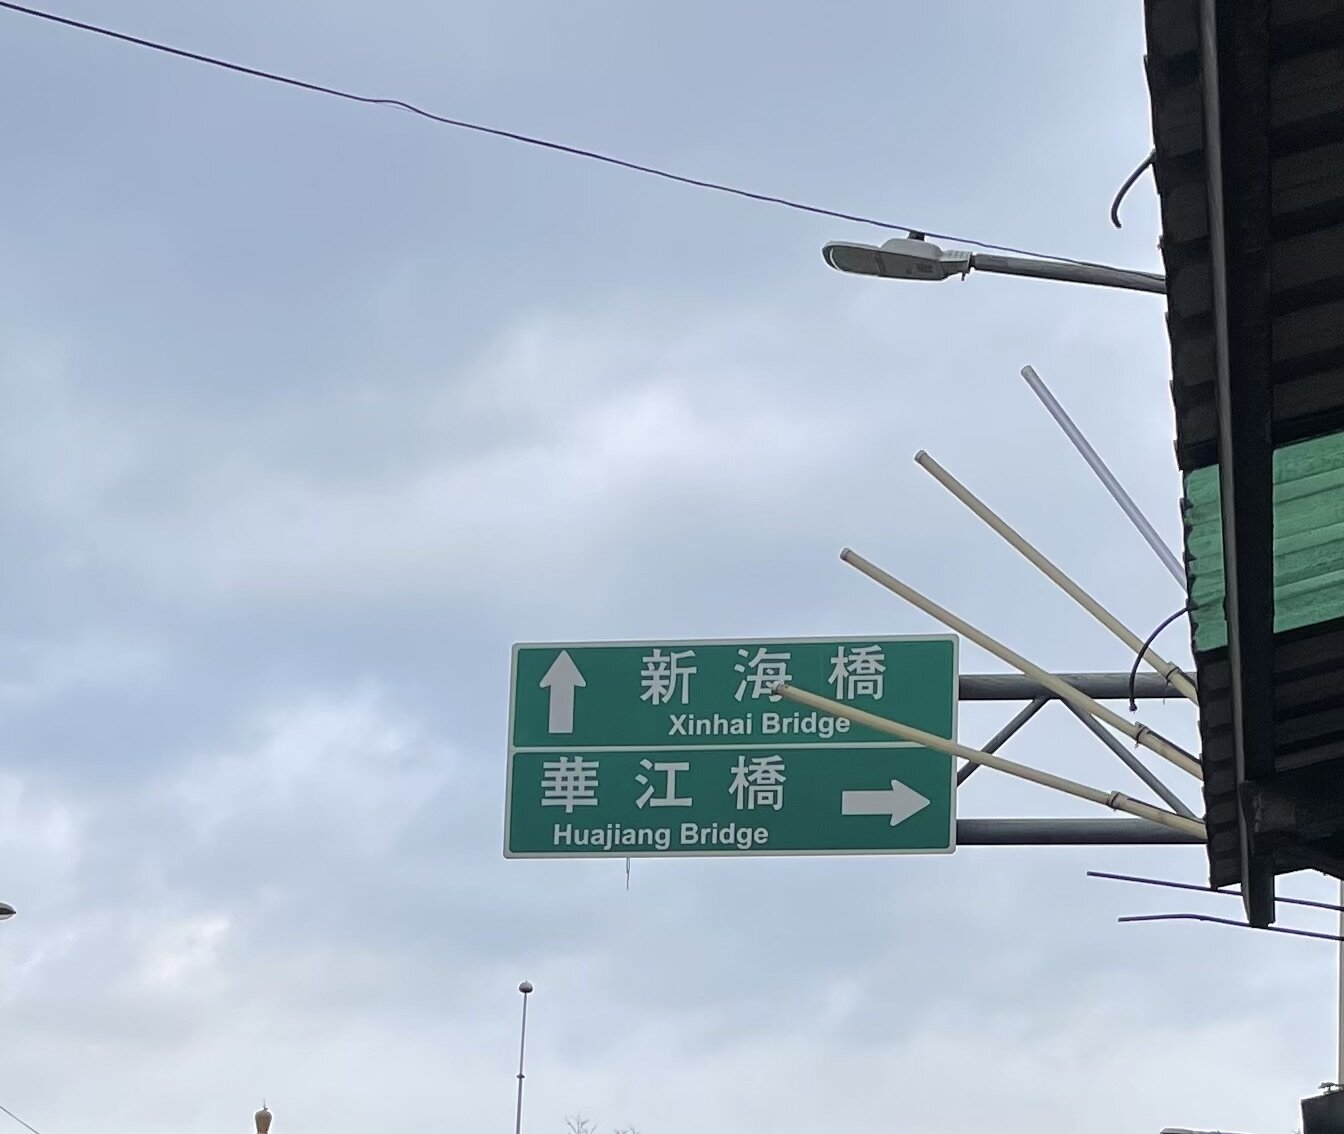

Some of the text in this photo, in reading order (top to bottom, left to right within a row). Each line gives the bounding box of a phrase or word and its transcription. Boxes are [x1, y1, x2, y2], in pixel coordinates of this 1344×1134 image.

[640, 644, 886, 705] 新海橋
[669, 711, 851, 739] Xinhai Bridge
[541, 755, 787, 813] 華江橋
[553, 821, 769, 850] Huajiang Bridge
